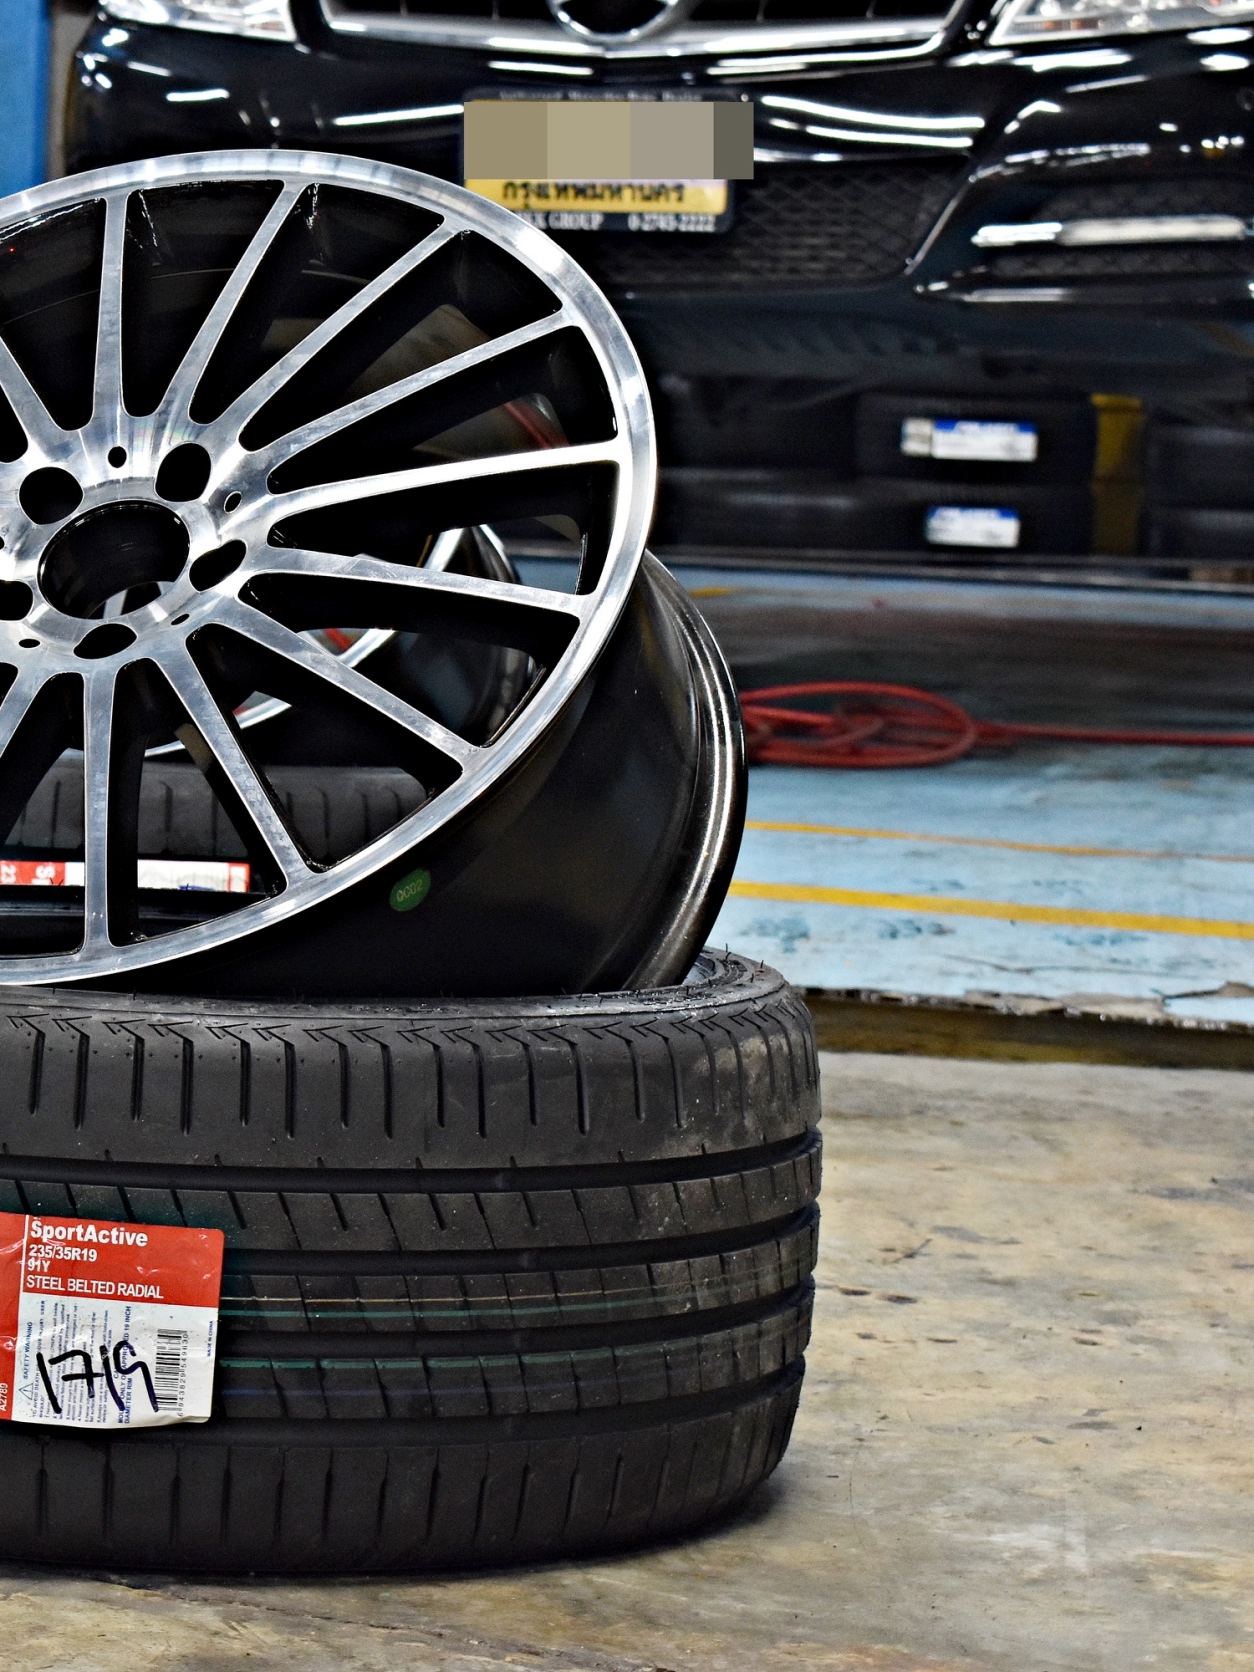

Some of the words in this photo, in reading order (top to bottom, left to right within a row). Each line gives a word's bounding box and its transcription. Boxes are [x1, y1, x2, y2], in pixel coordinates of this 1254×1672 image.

[549, 212, 604, 231] GROUP
[30, 1220, 148, 1247] SportActive
[29, 1244, 98, 1262] 235/35R19
[27, 1259, 50, 1272] 91Y
[26, 1275, 65, 1291] STEEL
[67, 1278, 116, 1295] BELTED
[117, 1282, 164, 1299] RADIAL
[124, 1323, 130, 1331] 19
[24, 1321, 33, 1353] WARNING
